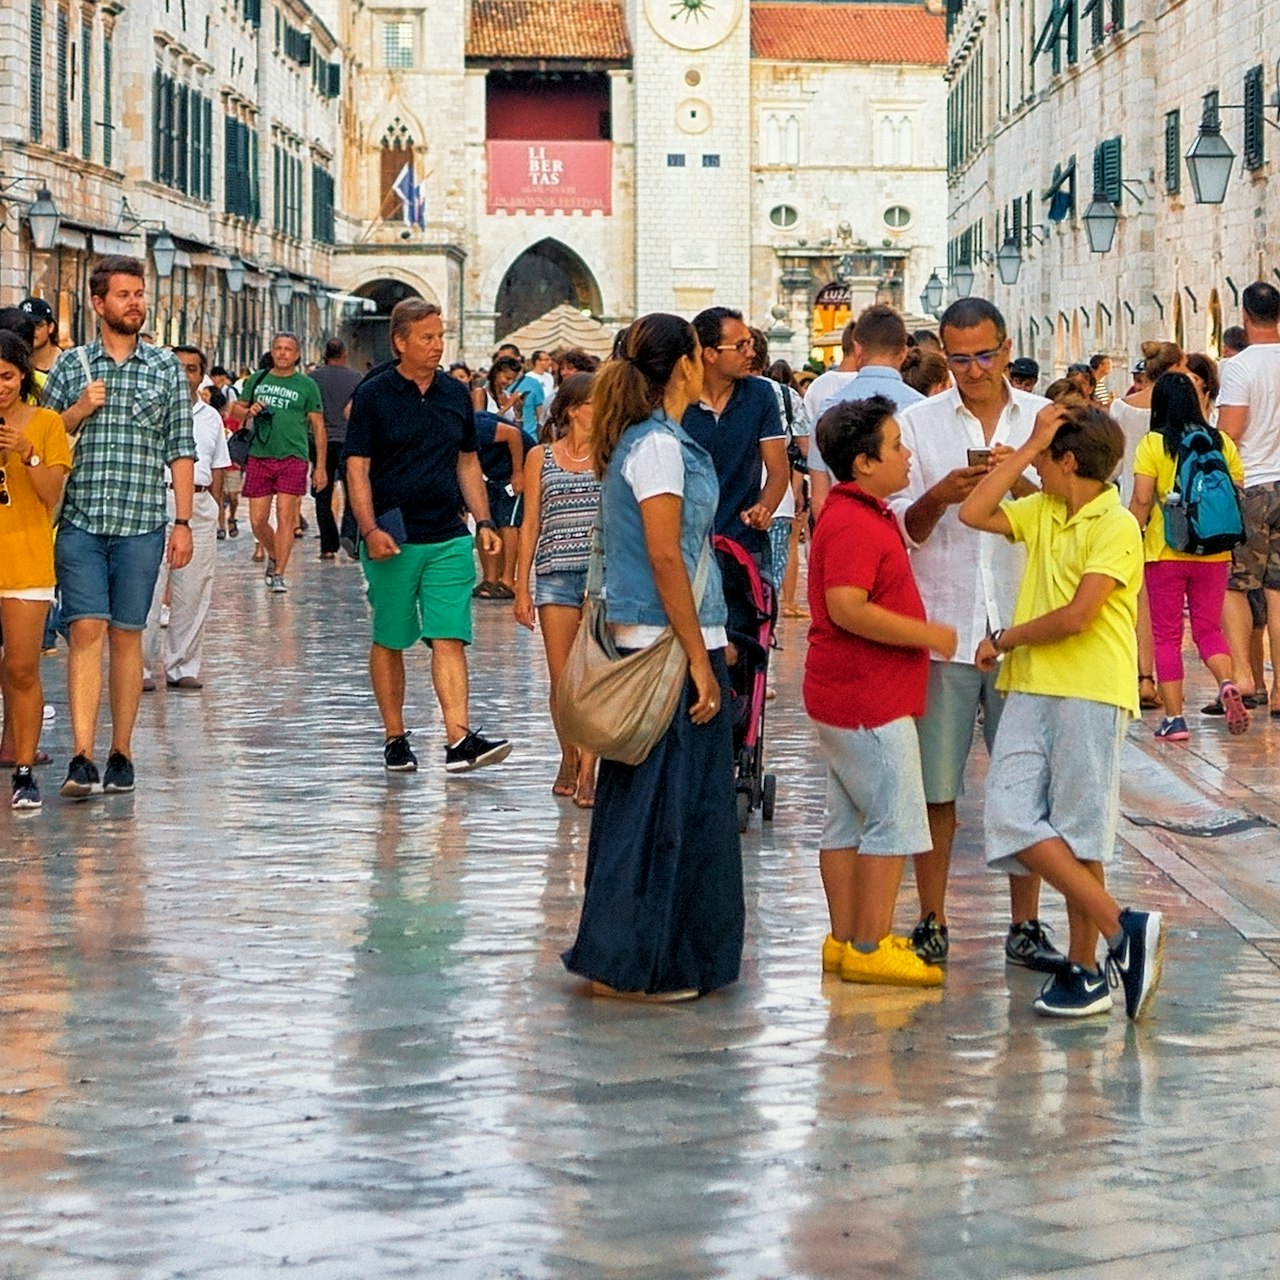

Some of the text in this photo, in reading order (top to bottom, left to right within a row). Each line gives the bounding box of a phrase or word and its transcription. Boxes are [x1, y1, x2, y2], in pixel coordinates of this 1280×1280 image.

[528, 146, 545, 159] LI
[528, 160, 564, 172] BER
[529, 173, 560, 185] TAS
[254, 384, 299, 401] RICHMOND
